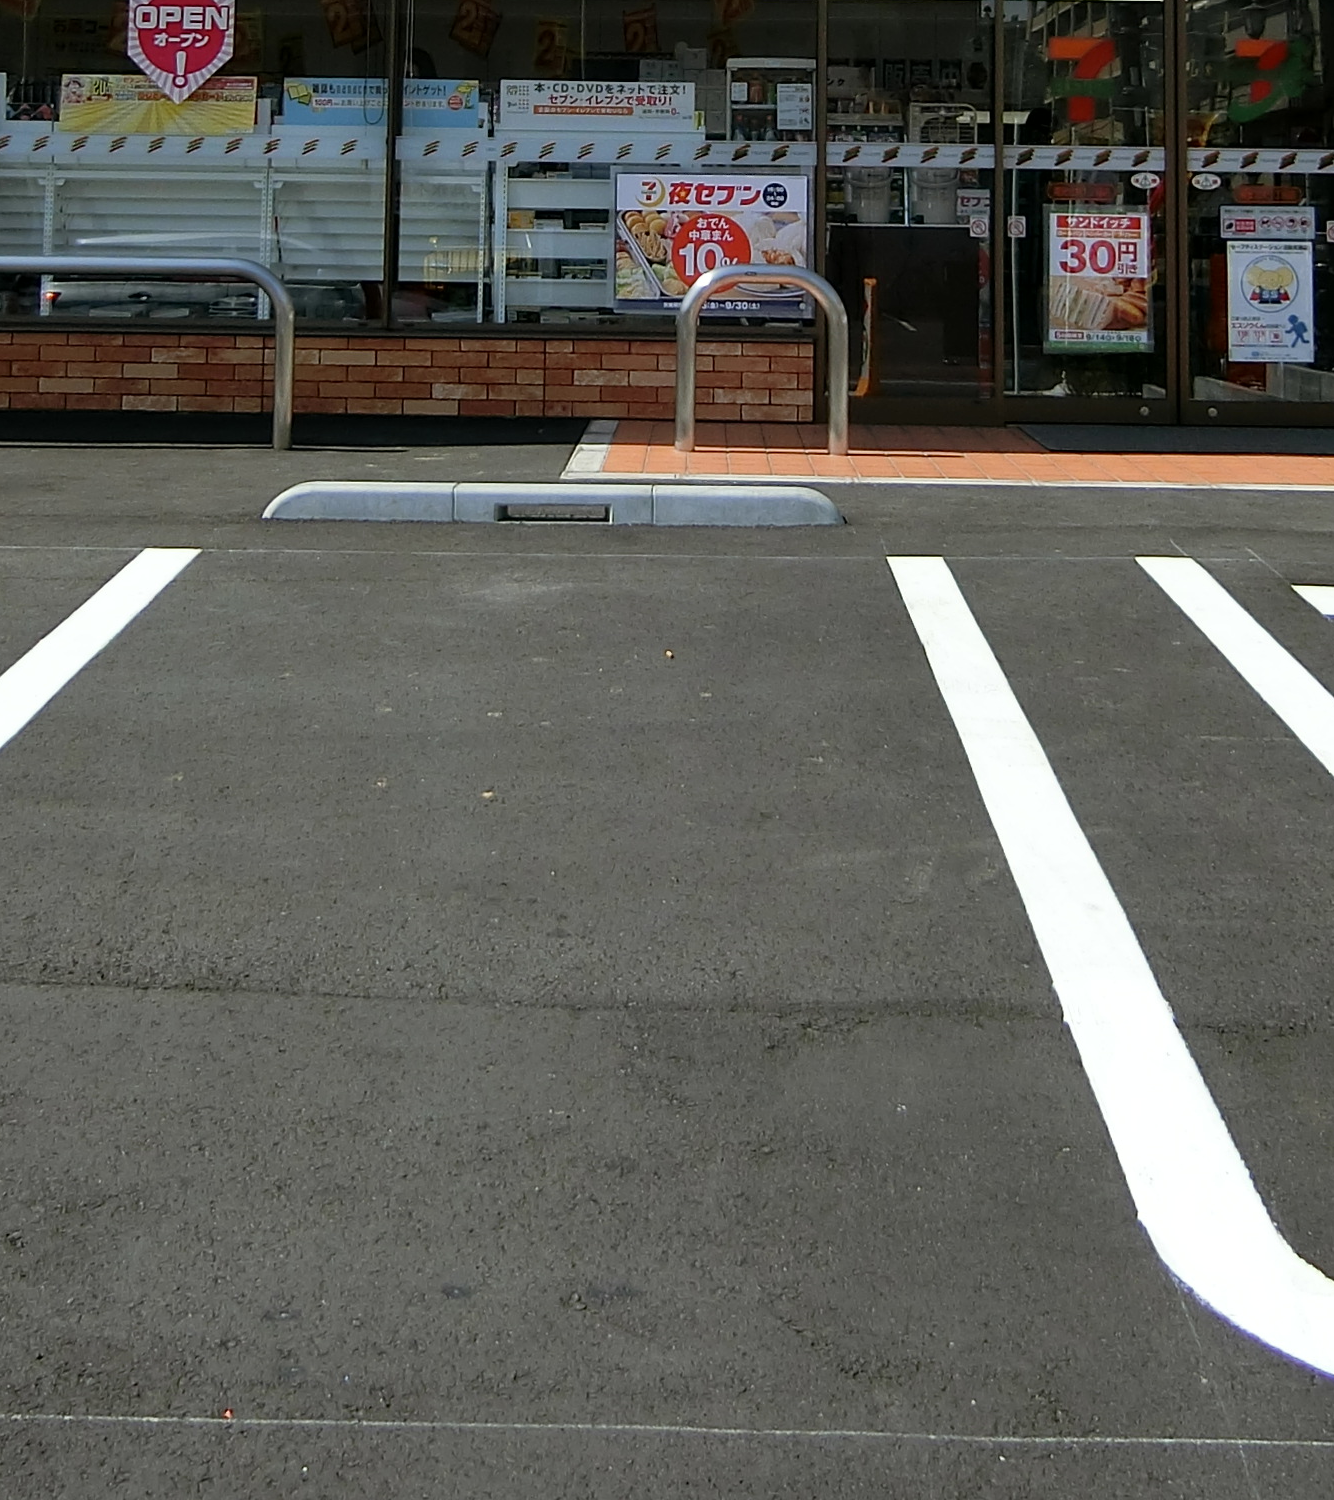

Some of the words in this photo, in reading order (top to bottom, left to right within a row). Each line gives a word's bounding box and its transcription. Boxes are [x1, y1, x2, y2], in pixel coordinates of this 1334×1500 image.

[135, 5, 229, 31] OPEN
[154, 32, 209, 47] オープン
[668, 181, 762, 206] 夜セブン
[697, 217, 729, 229] おでん
[1066, 217, 1131, 228] サンドイッチ
[688, 230, 734, 241] 中華まん
